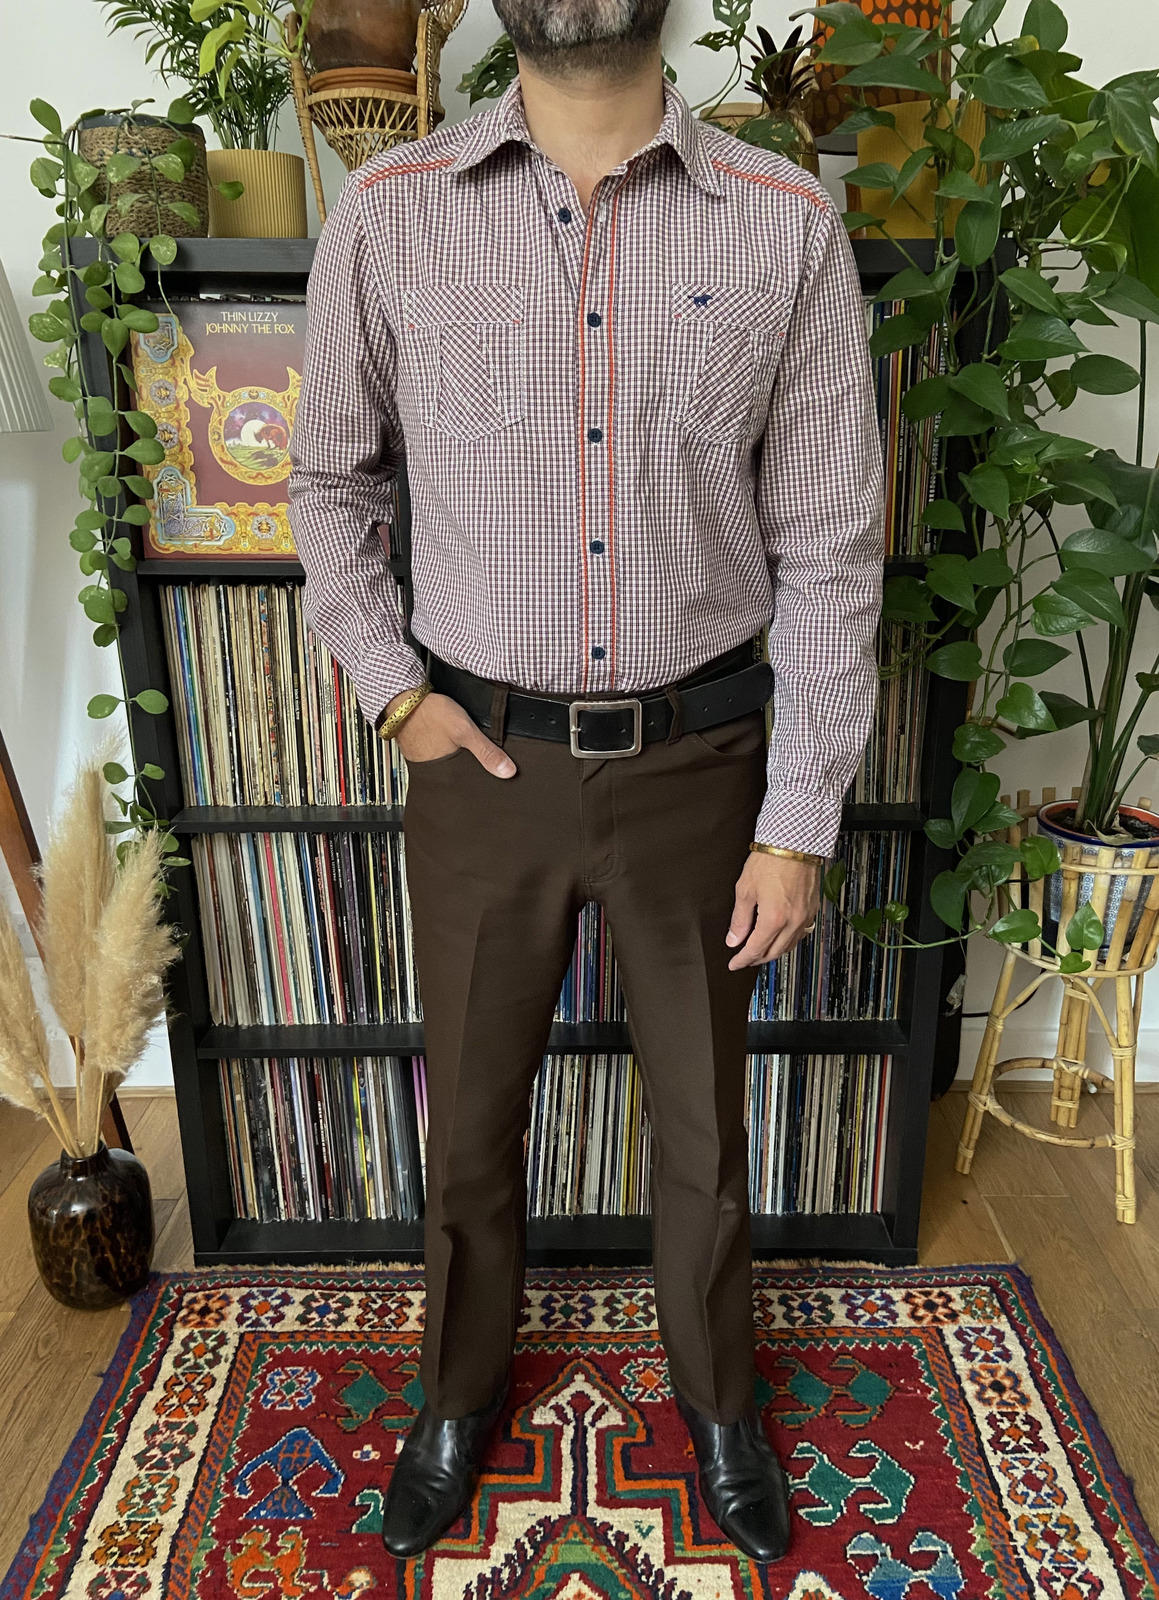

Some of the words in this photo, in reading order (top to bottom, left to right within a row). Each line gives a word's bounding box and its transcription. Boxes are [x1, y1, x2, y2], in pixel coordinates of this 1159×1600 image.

[220, 311, 246, 322] THIN
[248, 311, 279, 322] LIZZY
[205, 323, 248, 335] JOHNNY
[251, 323, 272, 334] THE
[274, 323, 295, 334] FOX
